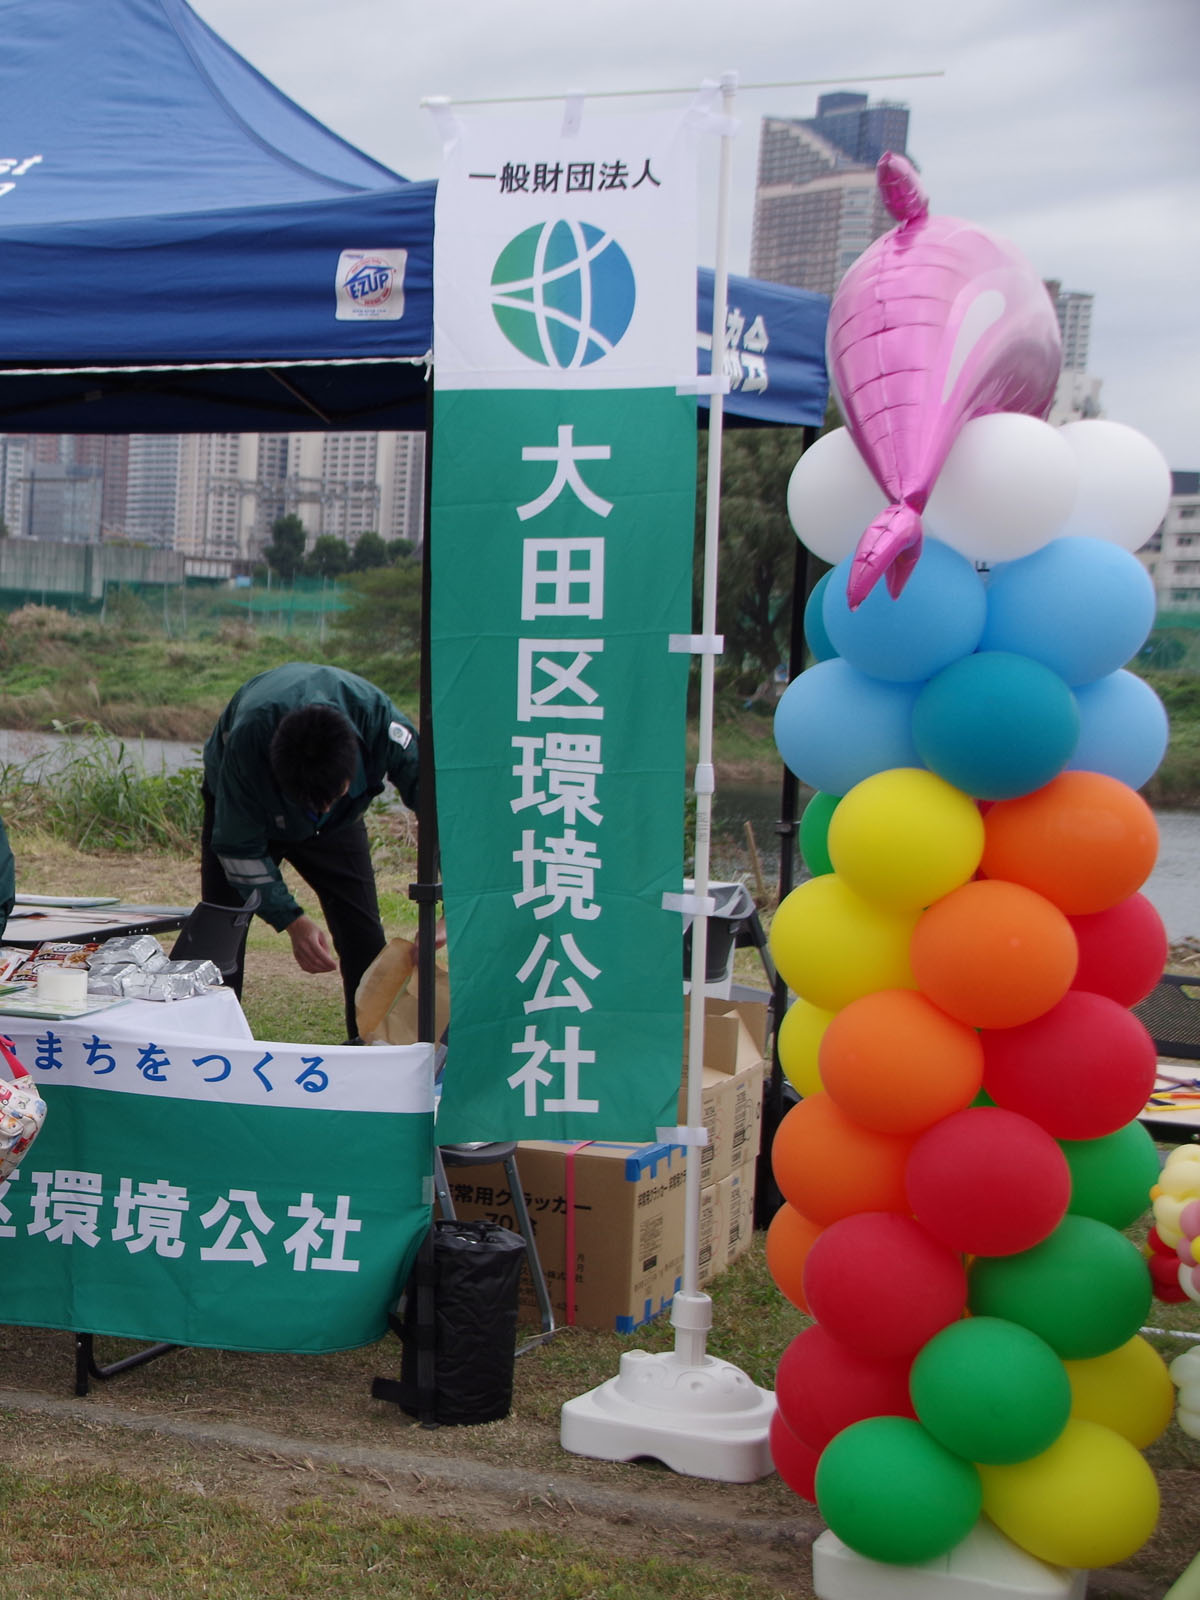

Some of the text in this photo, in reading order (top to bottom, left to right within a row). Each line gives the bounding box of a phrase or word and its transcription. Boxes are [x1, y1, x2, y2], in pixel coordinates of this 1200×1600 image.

[468, 158, 661, 195] 一般財団法人
[506, 424, 614, 1117] 大田区環境公社
